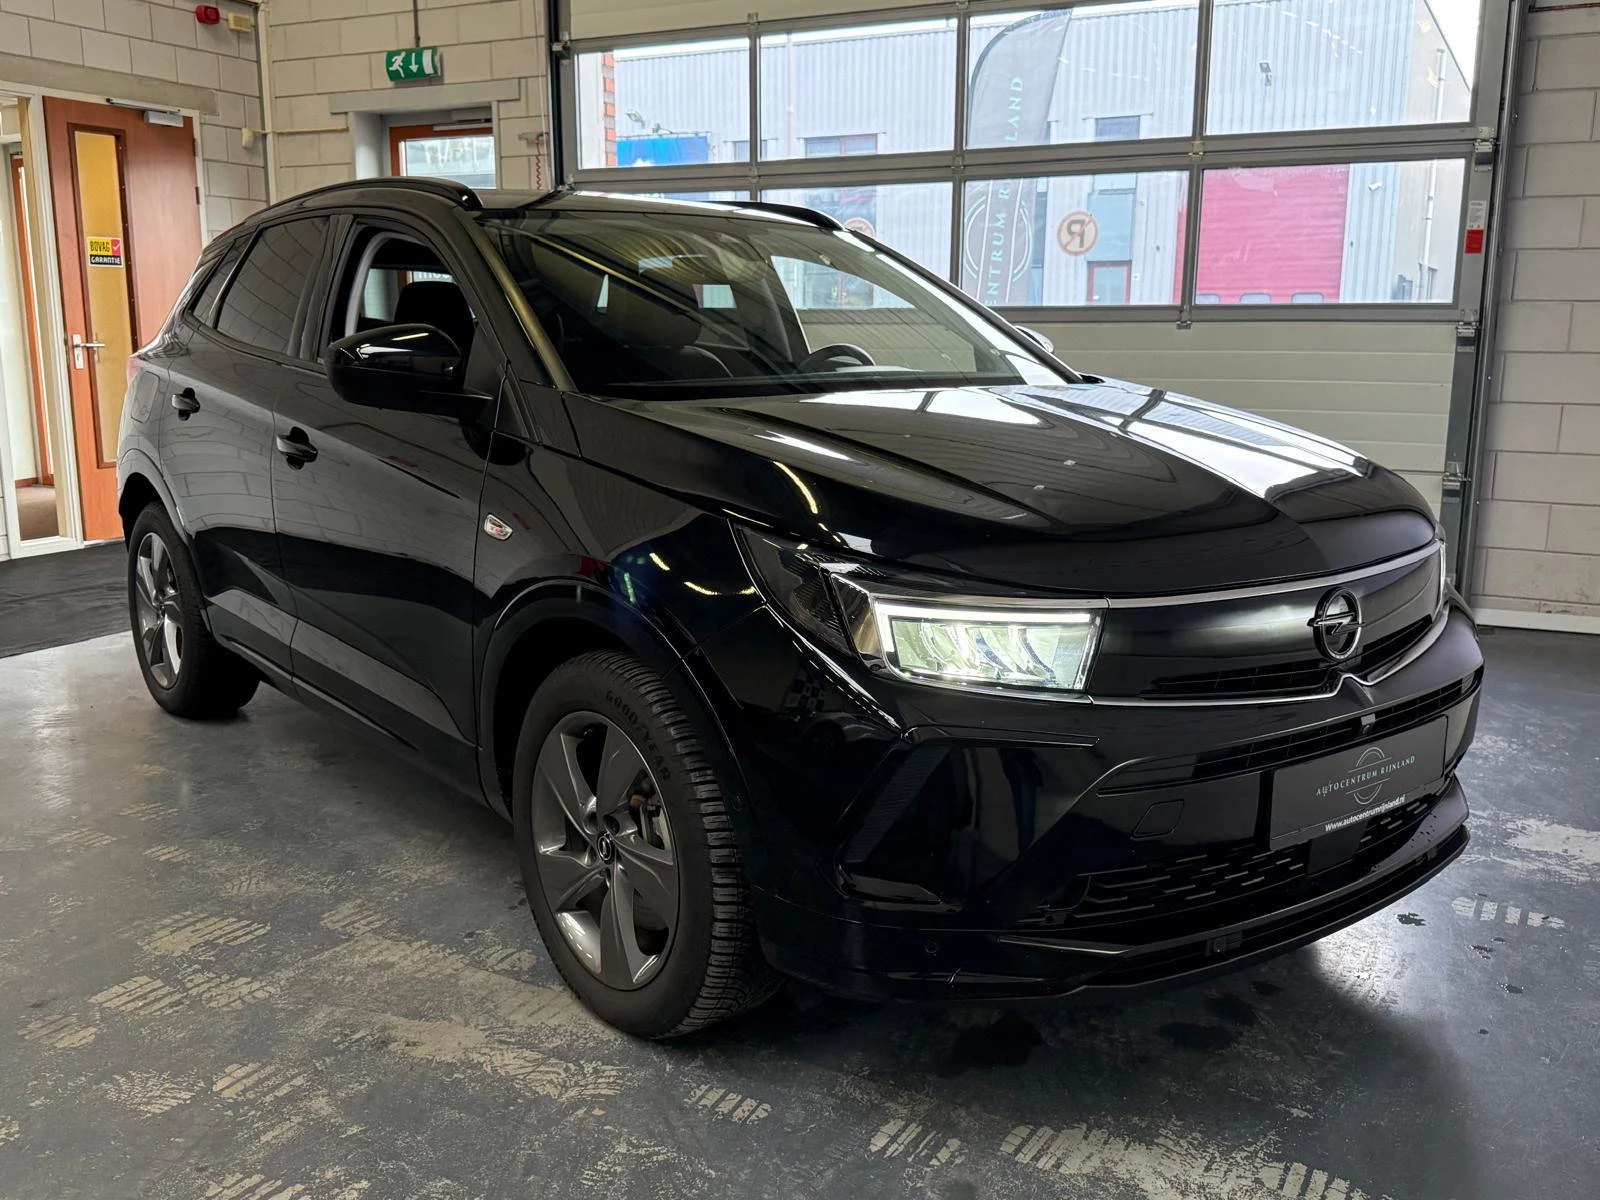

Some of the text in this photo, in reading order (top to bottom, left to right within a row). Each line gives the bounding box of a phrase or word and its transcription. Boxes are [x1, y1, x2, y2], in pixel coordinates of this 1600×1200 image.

[90, 241, 110, 253] BOVAG
[91, 255, 121, 265] GARANTIE
[1315, 755, 1416, 797] AUTOCENTRUM RIJNLAND
